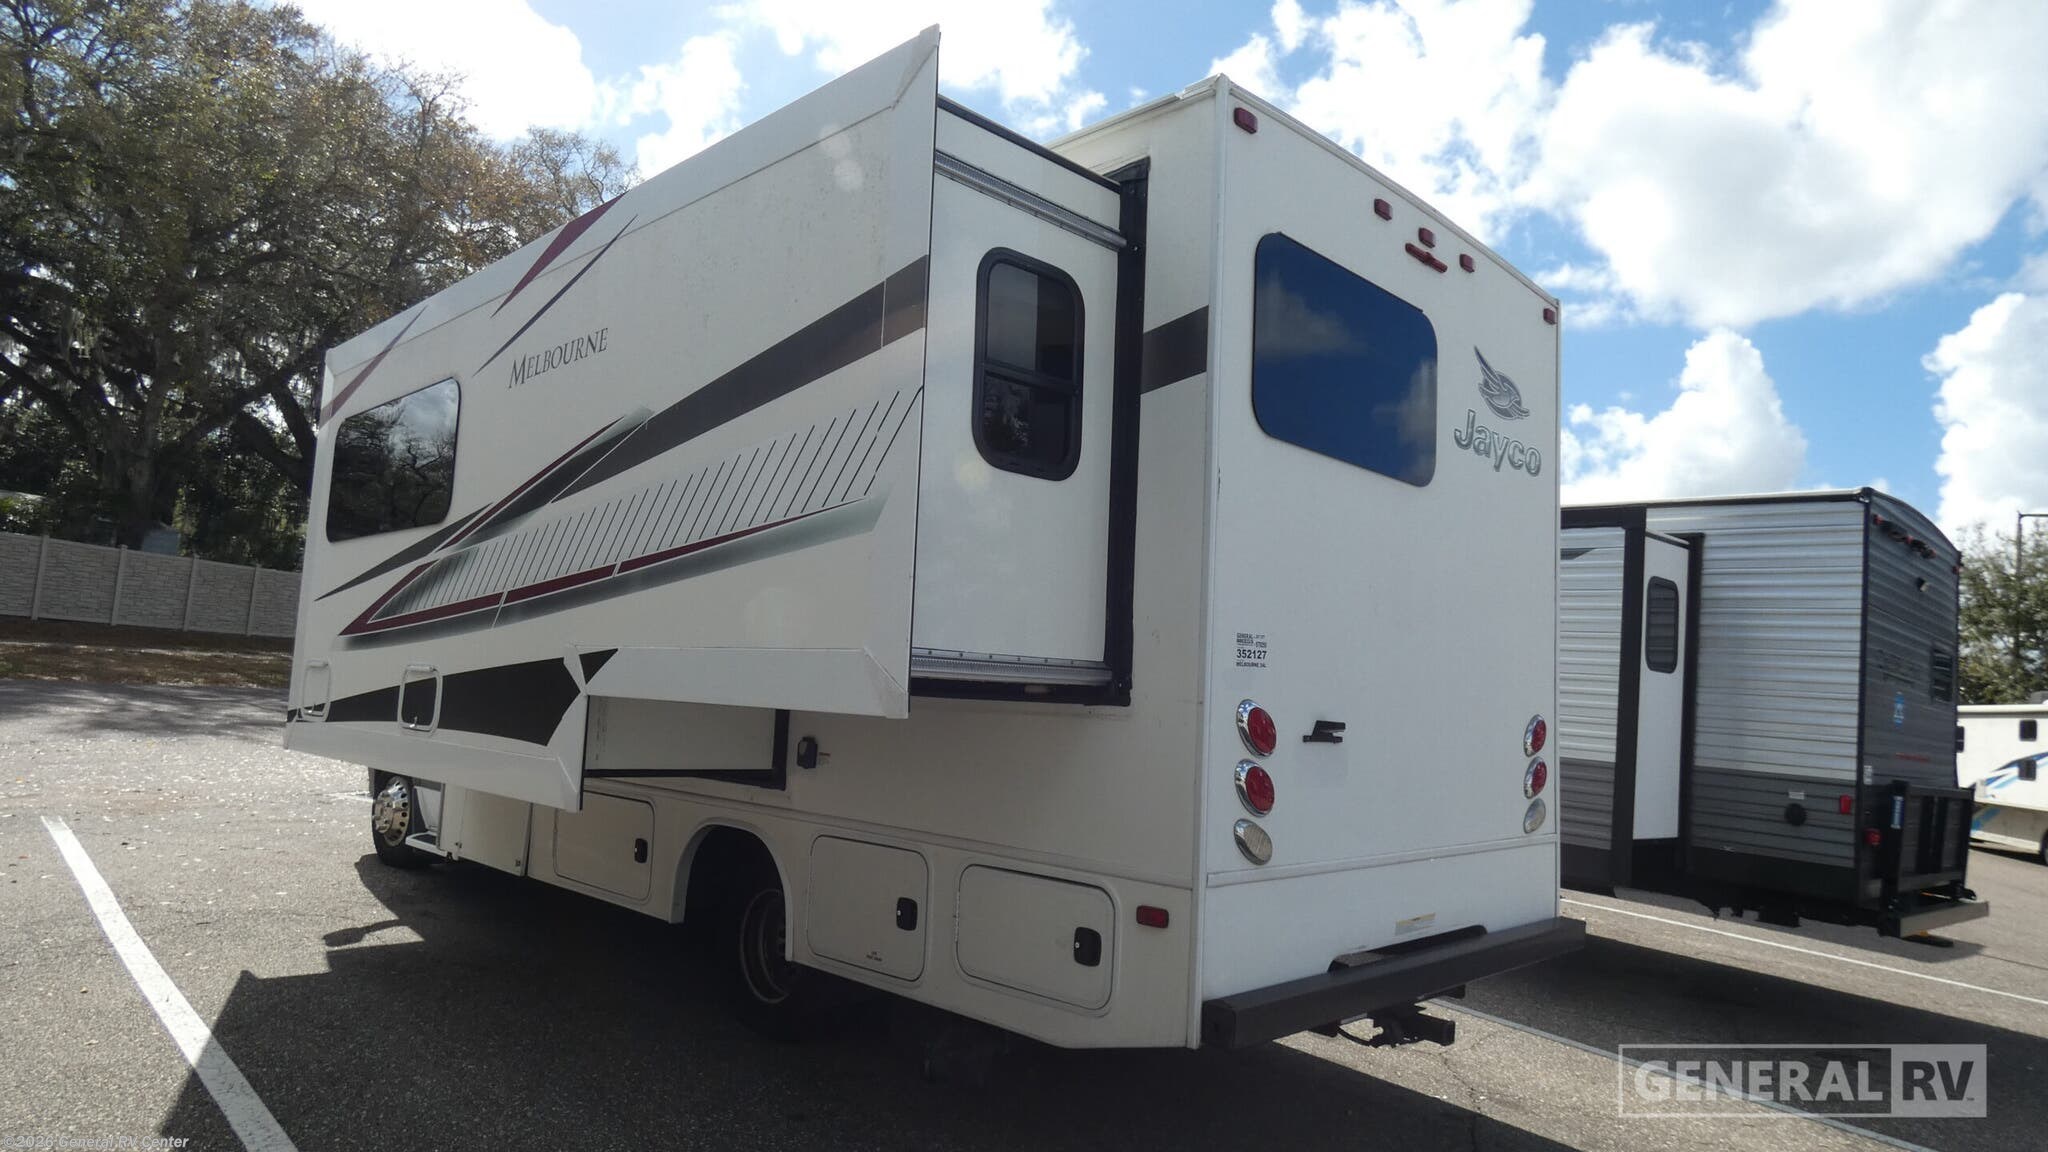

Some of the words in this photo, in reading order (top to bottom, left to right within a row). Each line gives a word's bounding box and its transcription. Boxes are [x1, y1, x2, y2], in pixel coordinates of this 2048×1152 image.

[508, 328, 608, 389] MELBOURNE
[1454, 409, 1542, 477] Jayco
[1236, 649, 1267, 659] 352127
